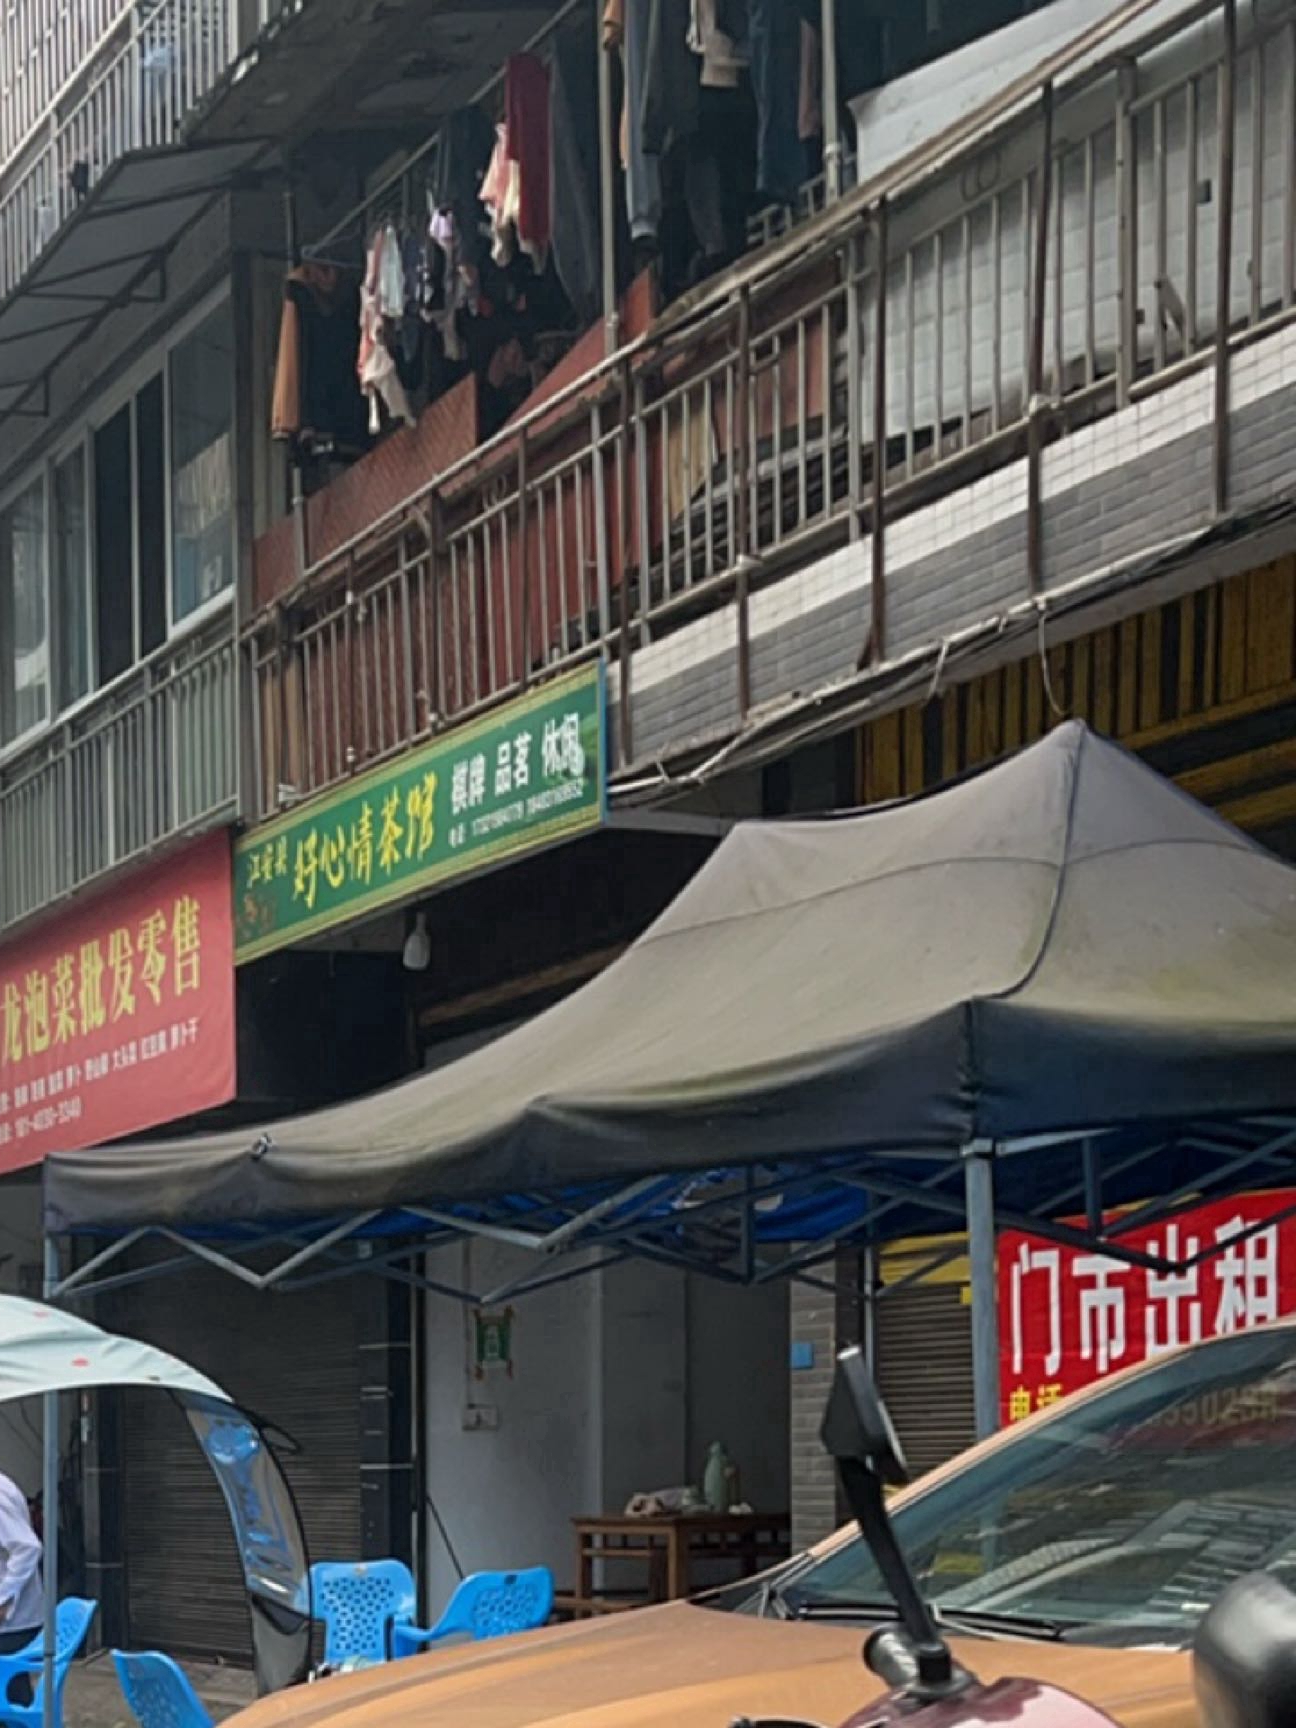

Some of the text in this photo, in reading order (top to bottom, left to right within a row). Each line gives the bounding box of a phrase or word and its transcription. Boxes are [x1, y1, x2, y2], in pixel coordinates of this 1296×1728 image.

[495, 732, 532, 789] 品茗
[1011, 1215, 1278, 1376] 门市出租
